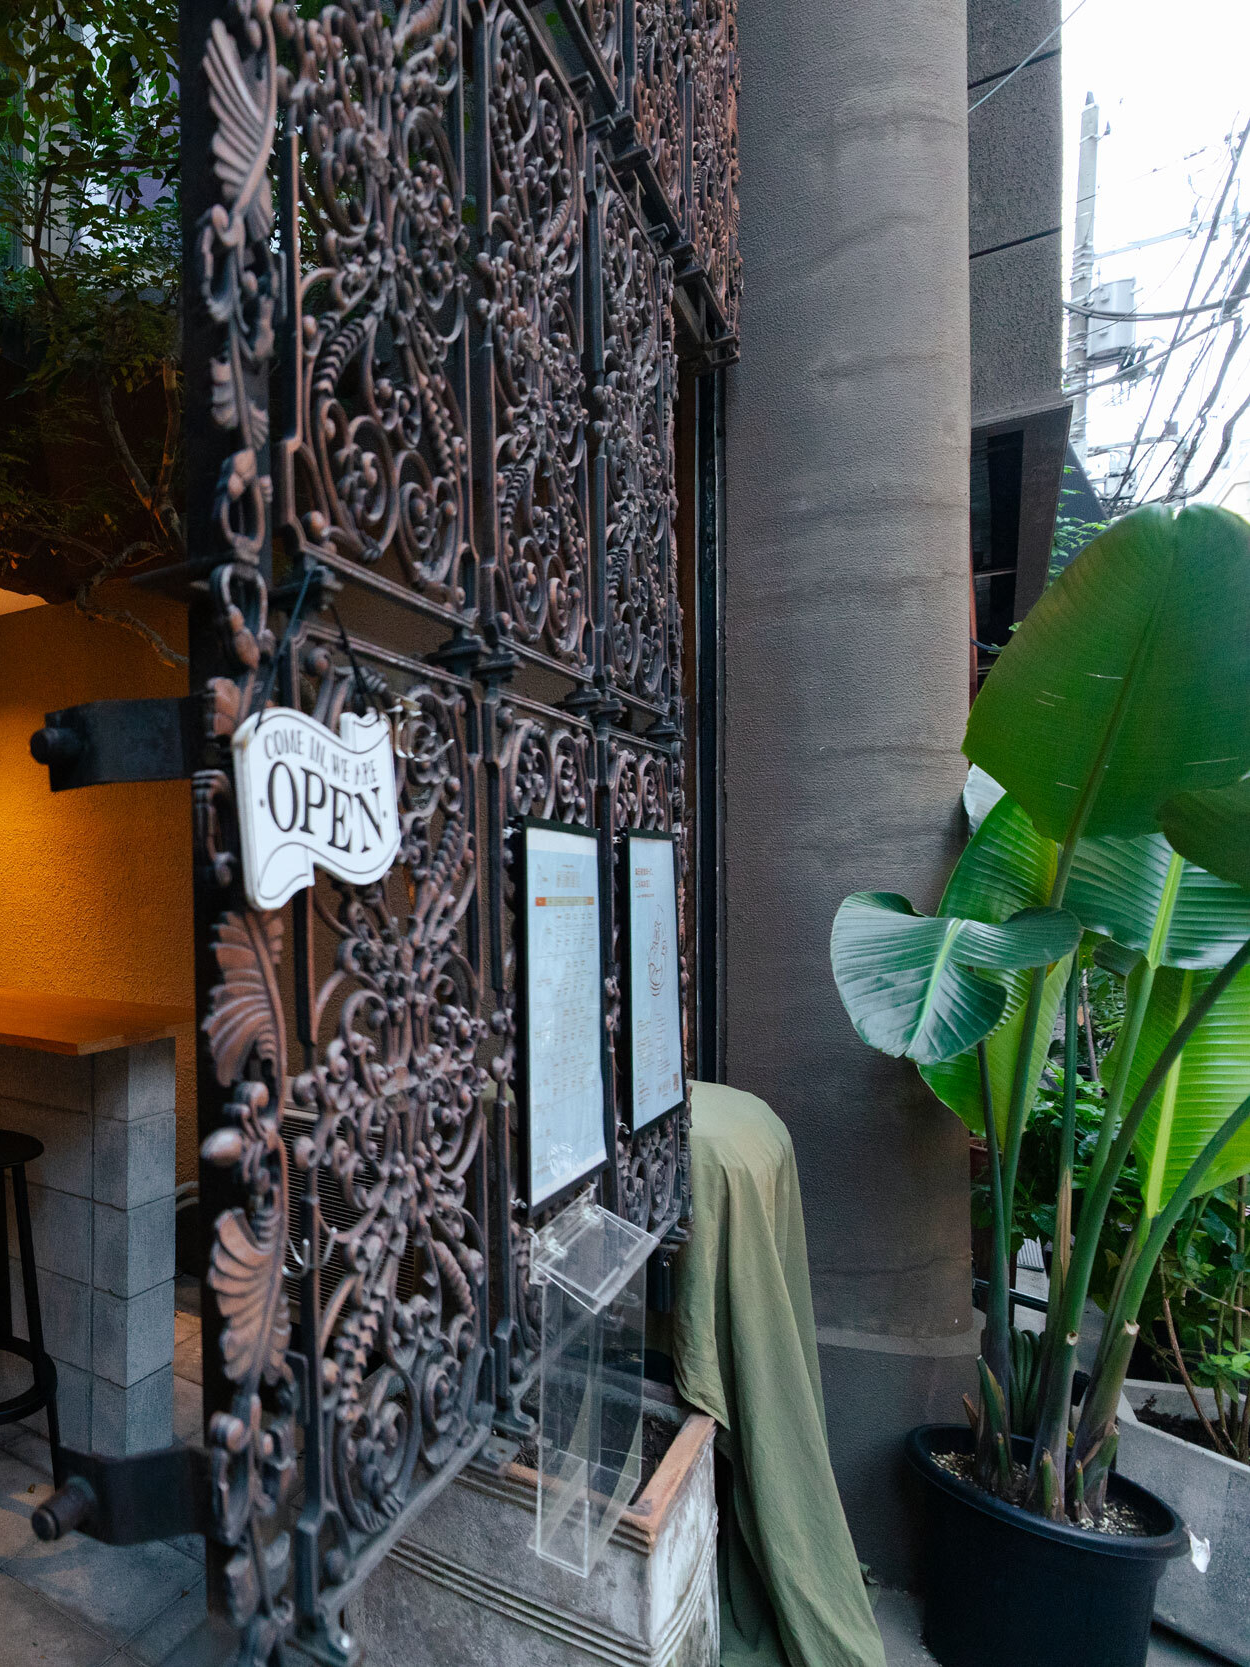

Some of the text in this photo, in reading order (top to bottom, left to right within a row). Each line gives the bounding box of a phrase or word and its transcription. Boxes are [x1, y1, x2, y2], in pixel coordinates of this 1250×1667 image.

[263, 728, 304, 760] COME
[331, 753, 349, 782] WE
[354, 758, 377, 785] ARE
[267, 760, 384, 854] OPEN
